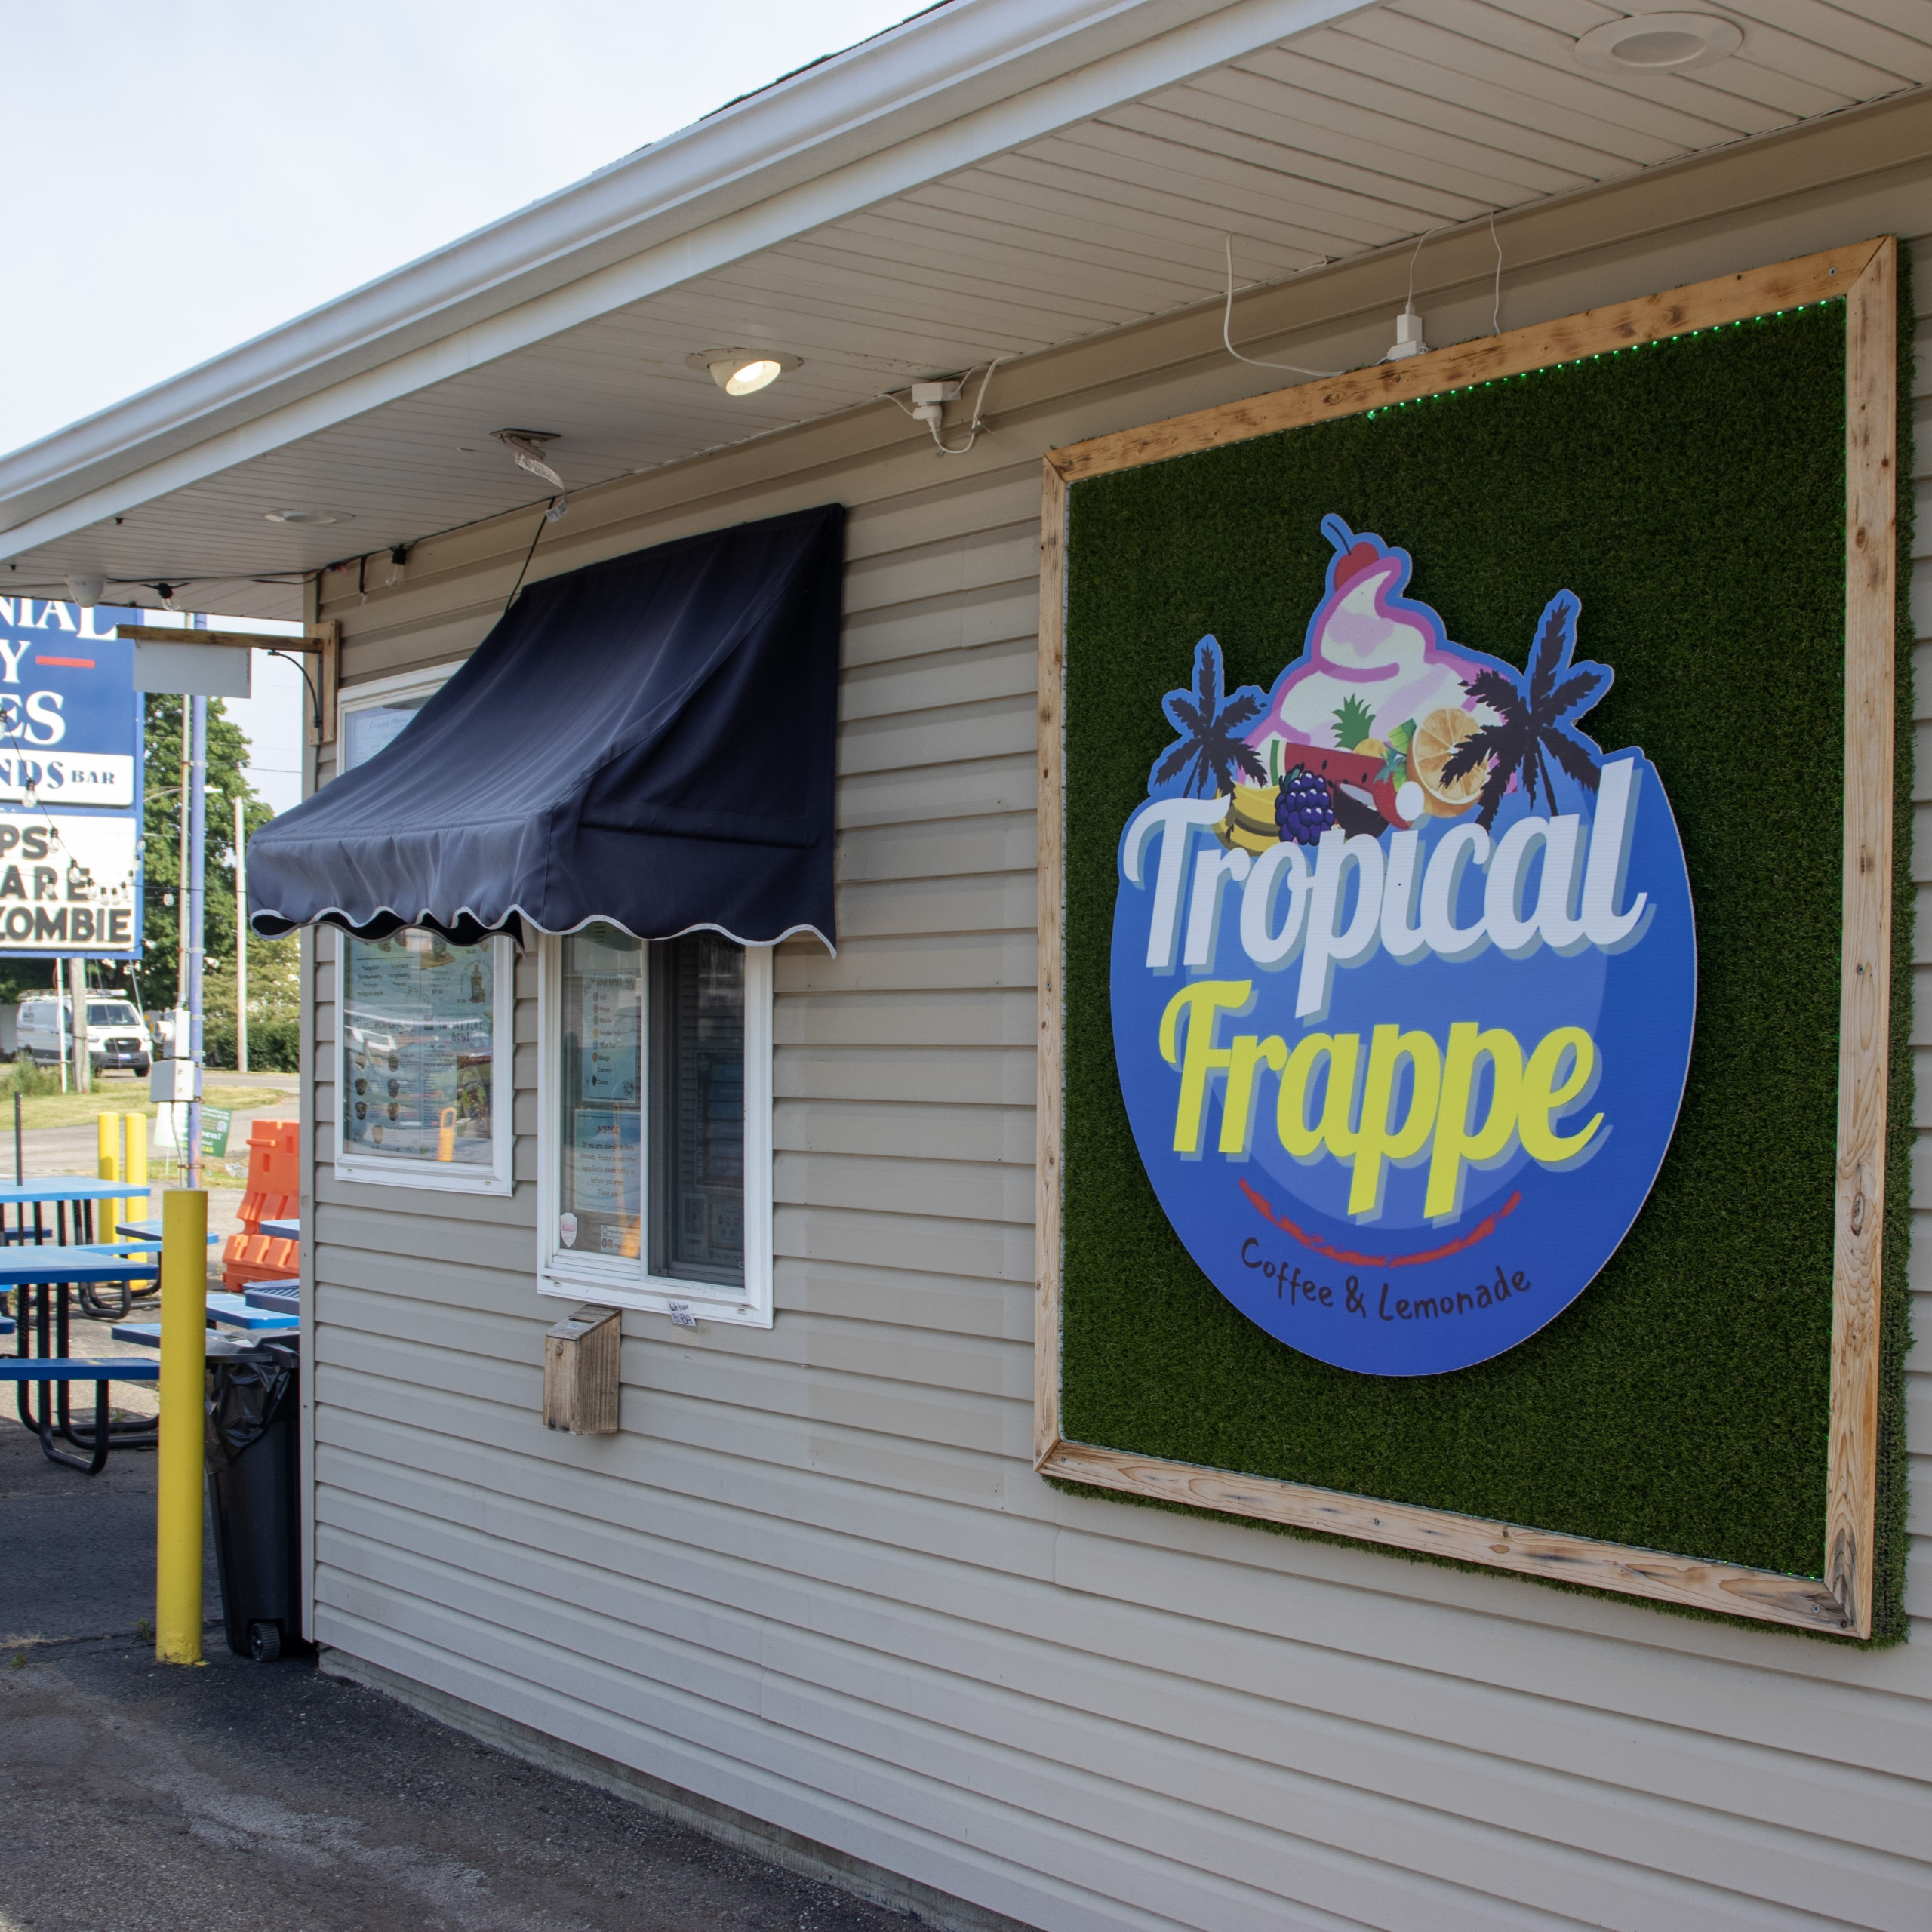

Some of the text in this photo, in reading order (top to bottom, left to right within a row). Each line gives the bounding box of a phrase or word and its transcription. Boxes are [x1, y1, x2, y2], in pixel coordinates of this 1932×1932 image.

[0, 638, 31, 684] Y
[0, 691, 66, 746] ES
[71, 769, 115, 785] BAR
[0, 823, 48, 860] PS
[1, 864, 91, 901] ARE
[1123, 757, 1651, 1022] Tropical
[0, 906, 132, 943] OMBIE
[1159, 979, 1608, 1223] Frappe
[598, 1125, 620, 1134] NOTICE
[1241, 1237, 1531, 1321] Coffee & Lemonade
